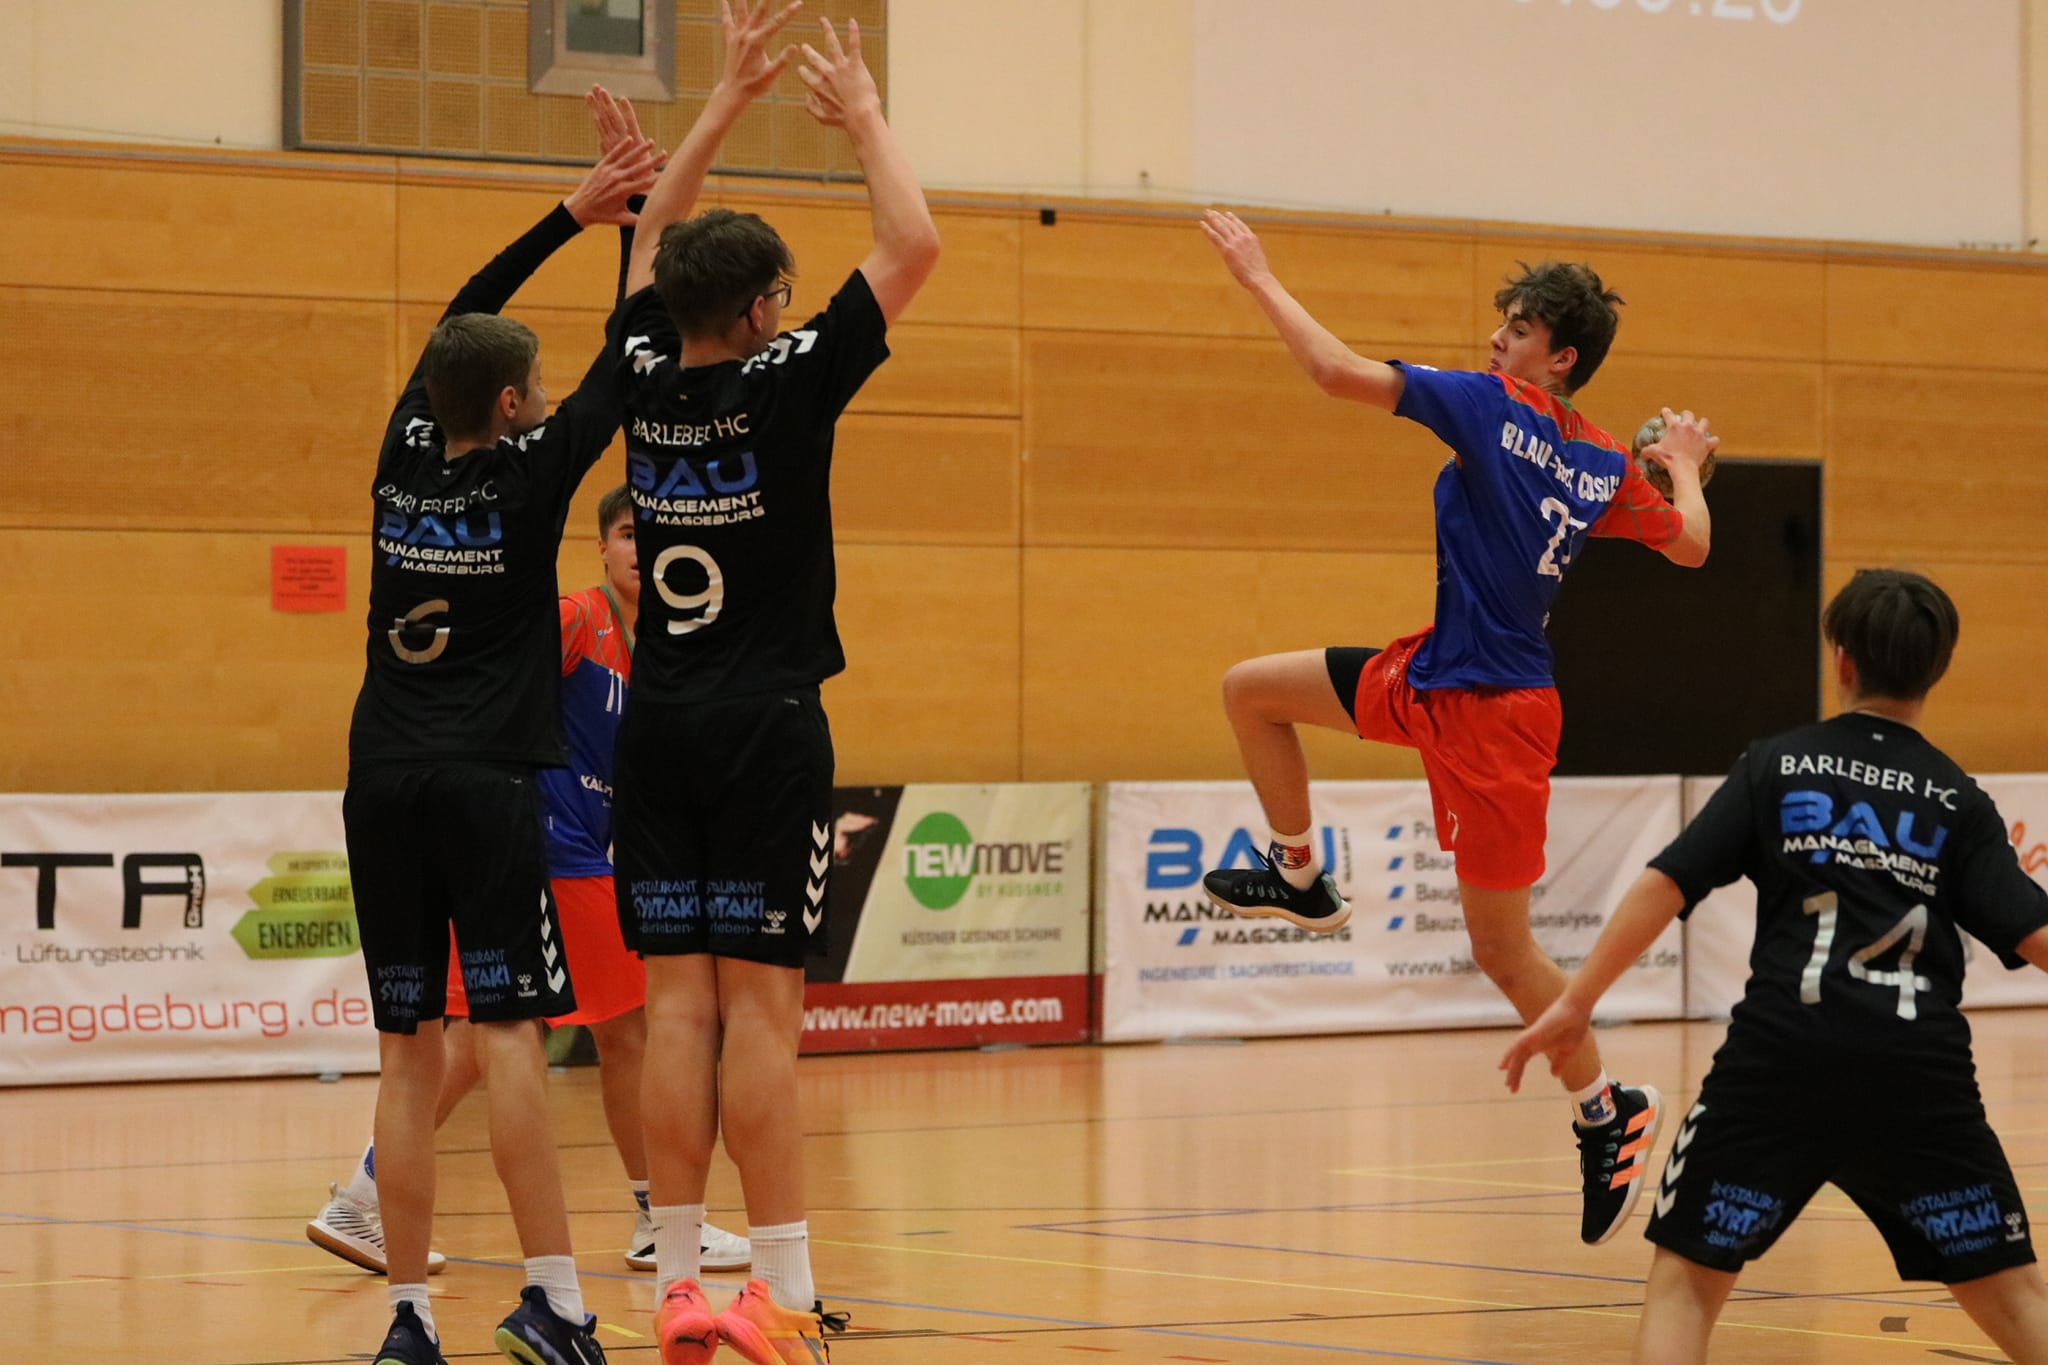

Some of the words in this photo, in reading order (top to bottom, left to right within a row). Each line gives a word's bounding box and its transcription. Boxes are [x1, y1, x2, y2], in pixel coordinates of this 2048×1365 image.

[713, 413, 750, 438] HC
[629, 451, 758, 498] BAU
[630, 487, 761, 513] MANAGEMENT
[655, 505, 765, 526] MAGDEBURG
[380, 508, 502, 547] BAU
[378, 537, 503, 563] MANAGEMENT
[401, 560, 505, 575] MAGDEBURG
[653, 545, 724, 635] 9
[388, 599, 450, 664] 6
[1780, 754, 1915, 795] BARLEBER
[1923, 778, 1959, 811] HC
[1779, 789, 1949, 859] BAU
[258, 920, 352, 949] ENERGIEN
[17, 942, 206, 967] Lüftungstechnik
[1801, 890, 1932, 1021] 14
[803, 997, 1062, 1031] www.new-move.com
